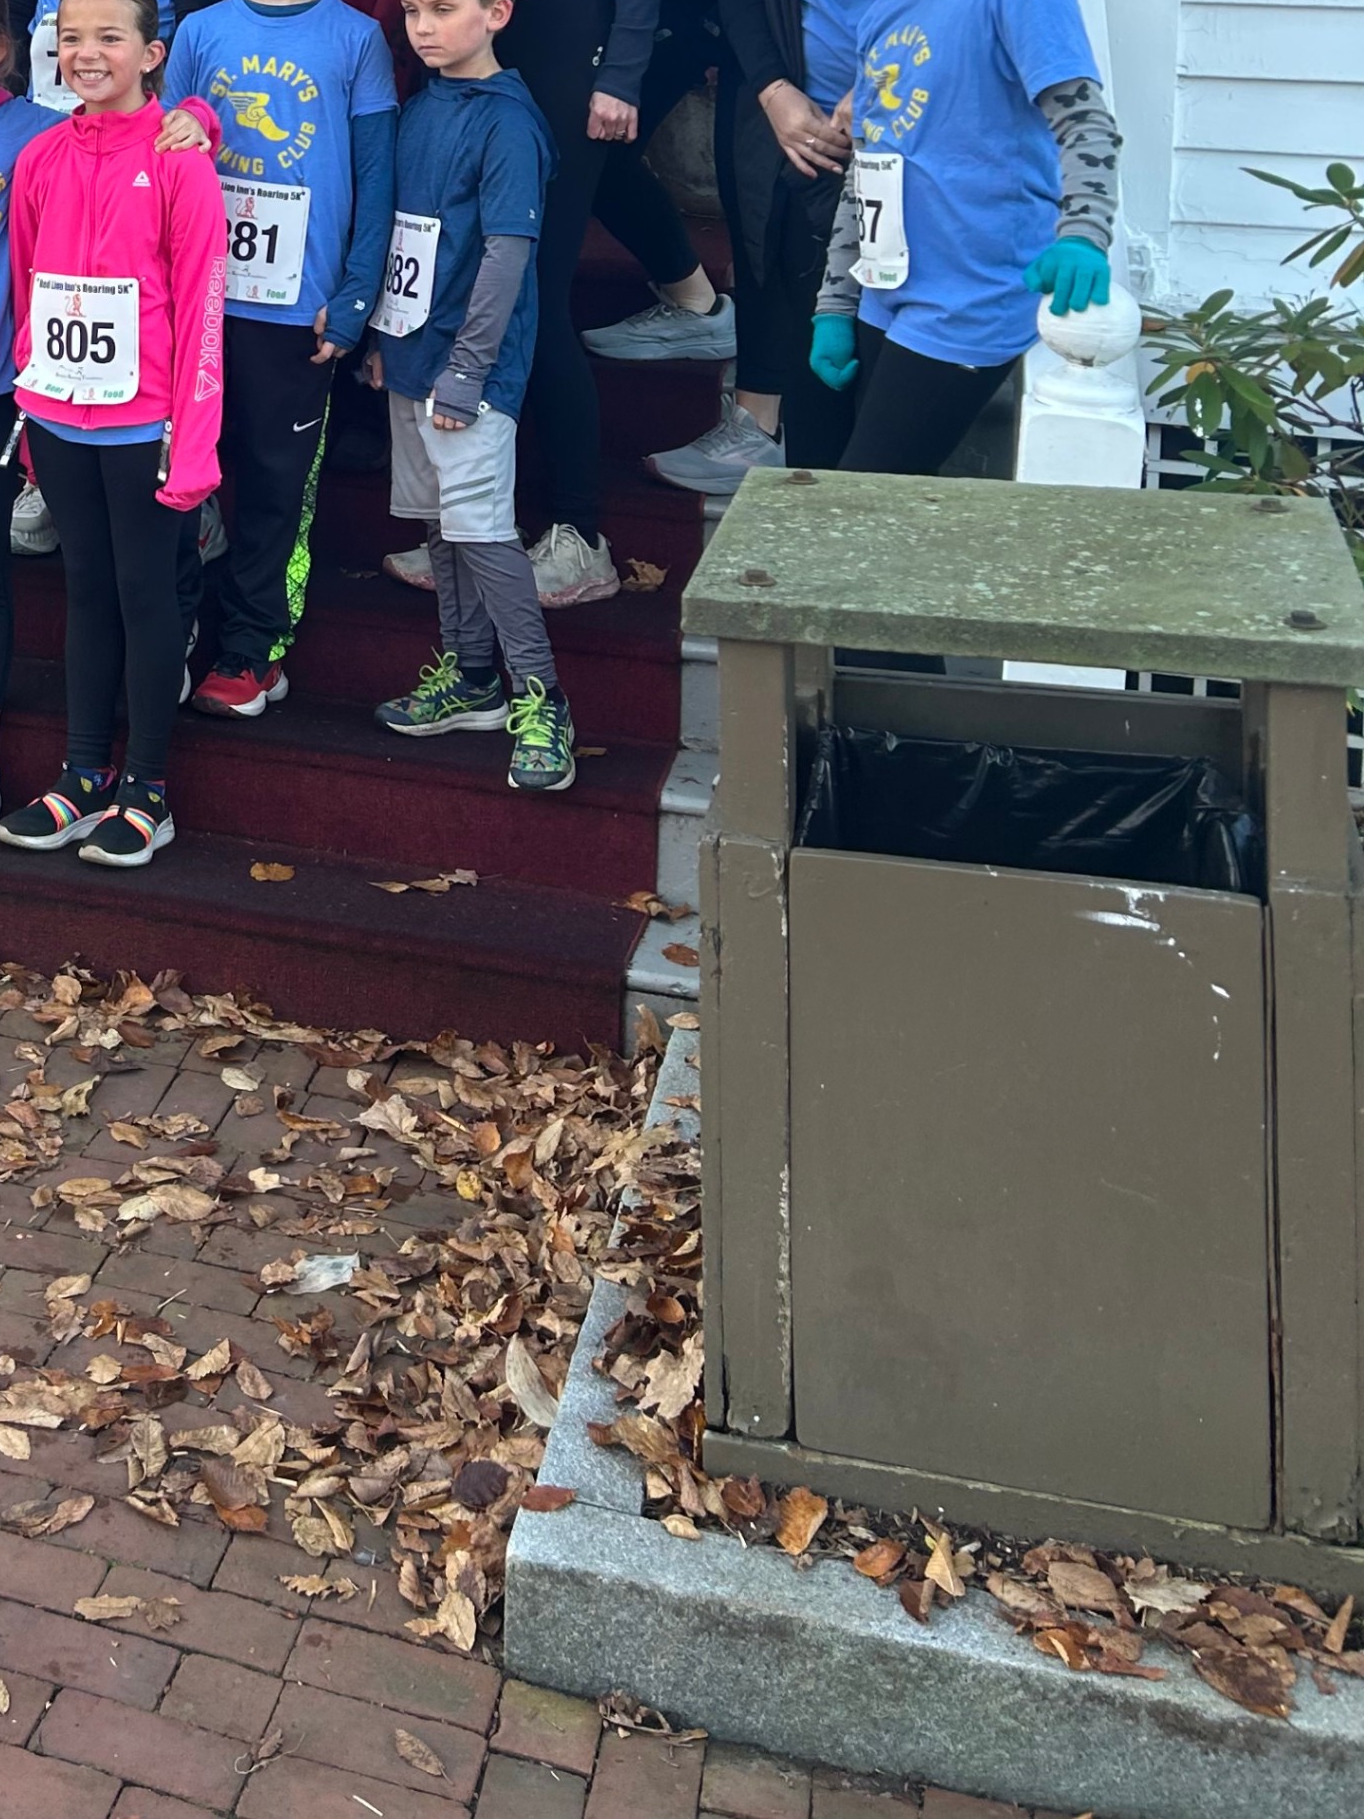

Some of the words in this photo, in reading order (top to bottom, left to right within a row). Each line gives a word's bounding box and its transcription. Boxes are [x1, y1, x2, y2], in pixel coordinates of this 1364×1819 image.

[210, 67, 238, 98] ST.
[241, 54, 319, 103] MARY'S
[892, 88, 930, 139] CLUB
[217, 143, 264, 176] NING
[277, 121, 317, 169] CLUB
[256, 186, 289, 201] Roaring
[225, 221, 279, 264] 81
[82, 283, 116, 295] Roaring
[266, 288, 287, 300] Food
[386, 252, 420, 299] 882
[198, 255, 227, 369] Reebok
[46, 317, 116, 364] 805
